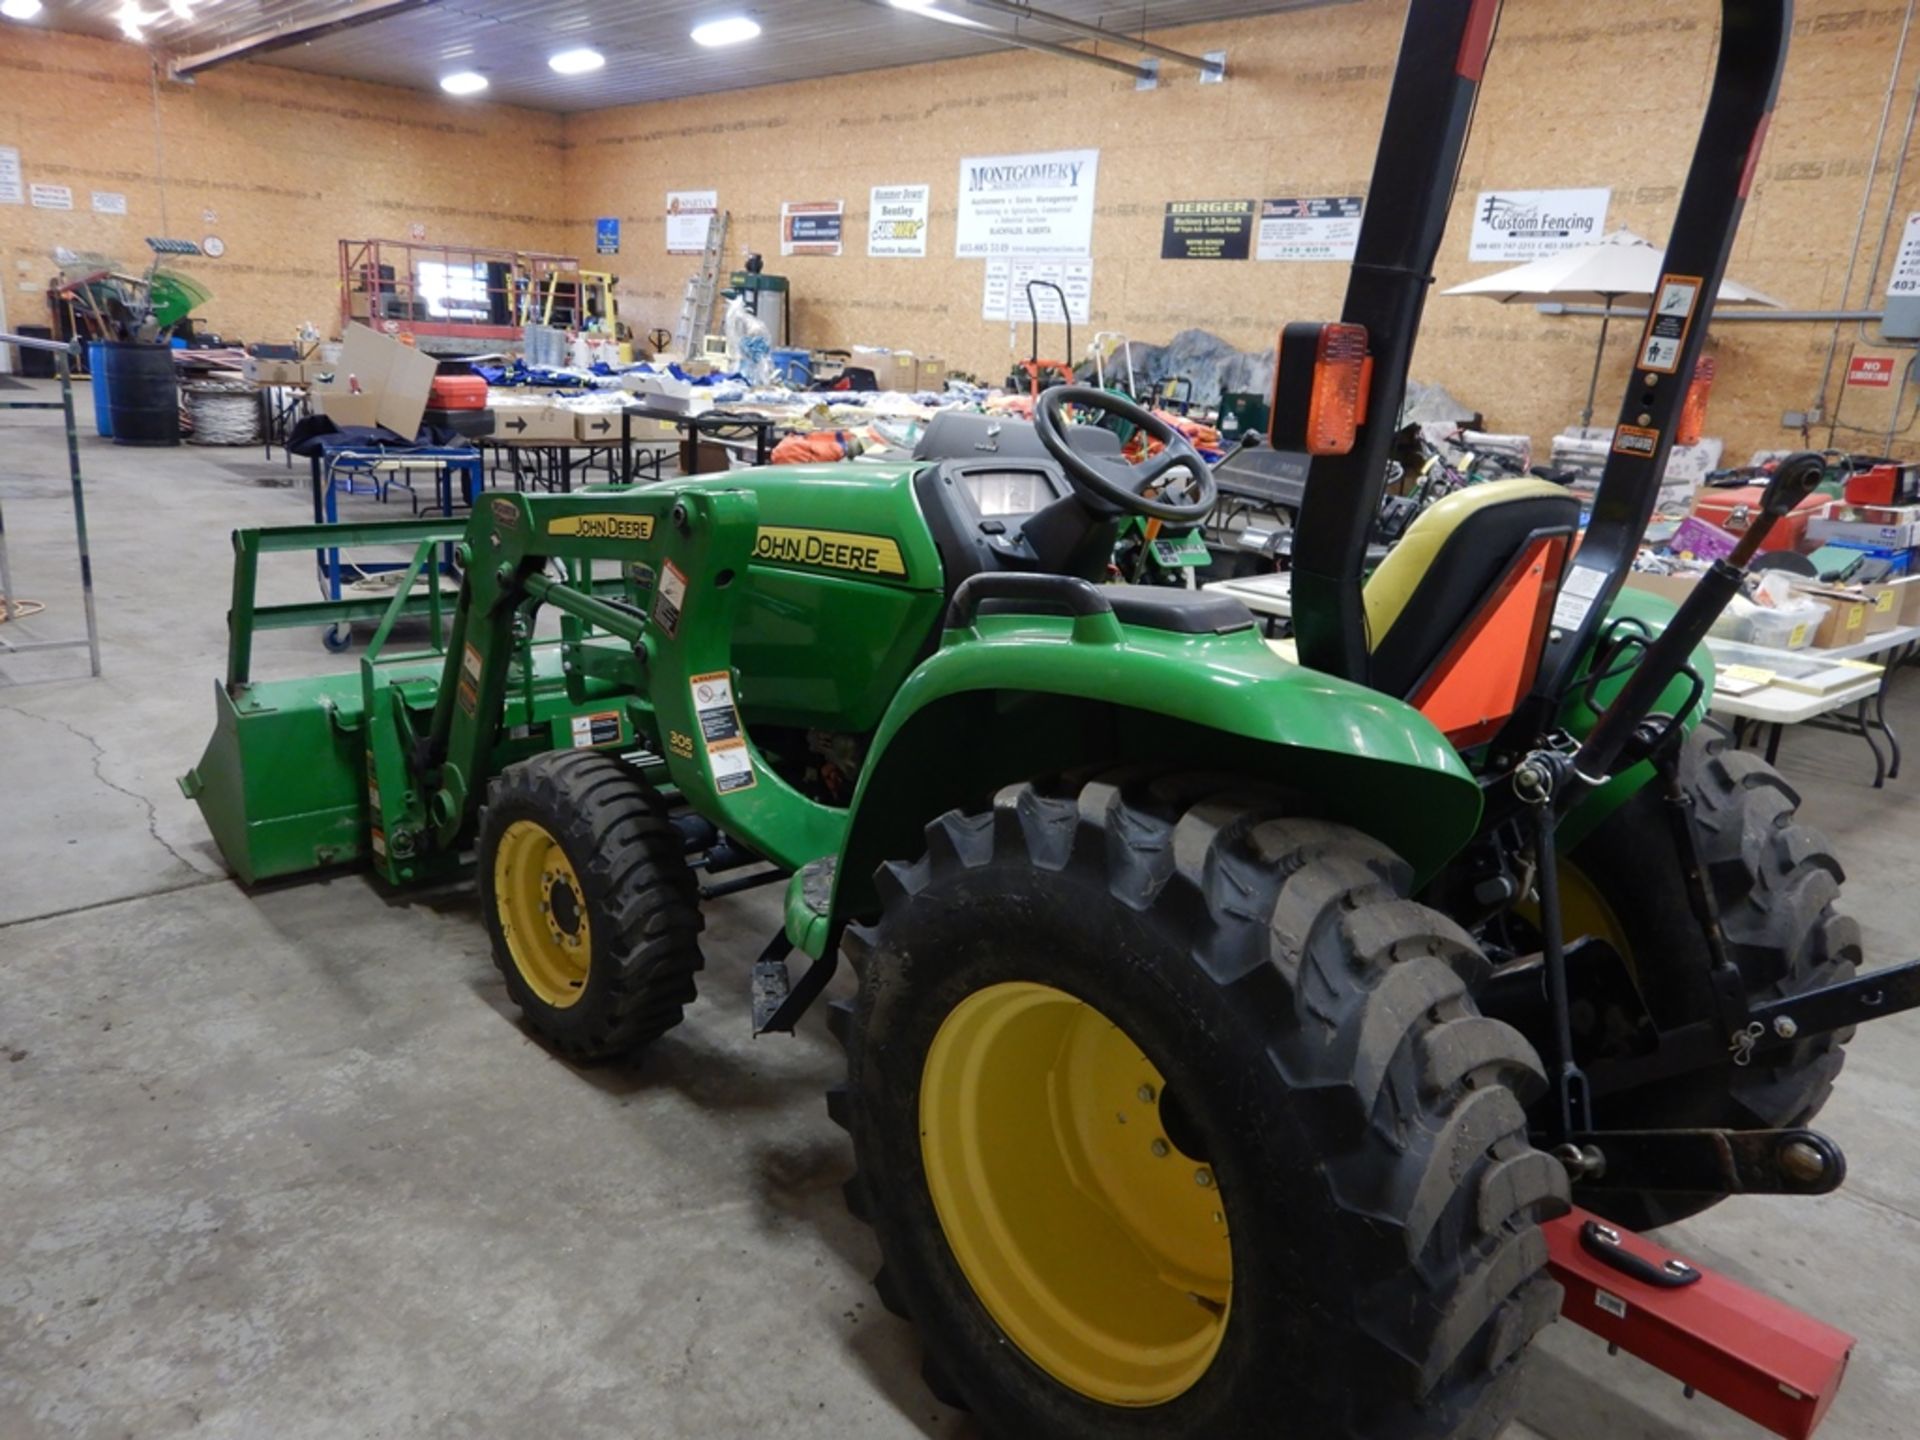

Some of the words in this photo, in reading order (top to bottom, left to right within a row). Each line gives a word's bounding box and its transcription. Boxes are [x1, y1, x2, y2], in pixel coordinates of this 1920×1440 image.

[969, 161, 1084, 192] MONTGOMERY
[1036, 195, 1079, 204] Management
[1171, 202, 1249, 213] BERGER
[882, 205, 914, 218] Bentley
[872, 219, 924, 241] SUBWAY
[1490, 214, 1539, 230] Custom
[1541, 213, 1594, 234] Fencing
[1862, 361, 1881, 370] NO
[576, 517, 606, 535] JOHN
[608, 517, 648, 537] DEERE
[757, 534, 801, 558] OHN
[805, 536, 880, 569] DEERE
[670, 730, 693, 751] 305
